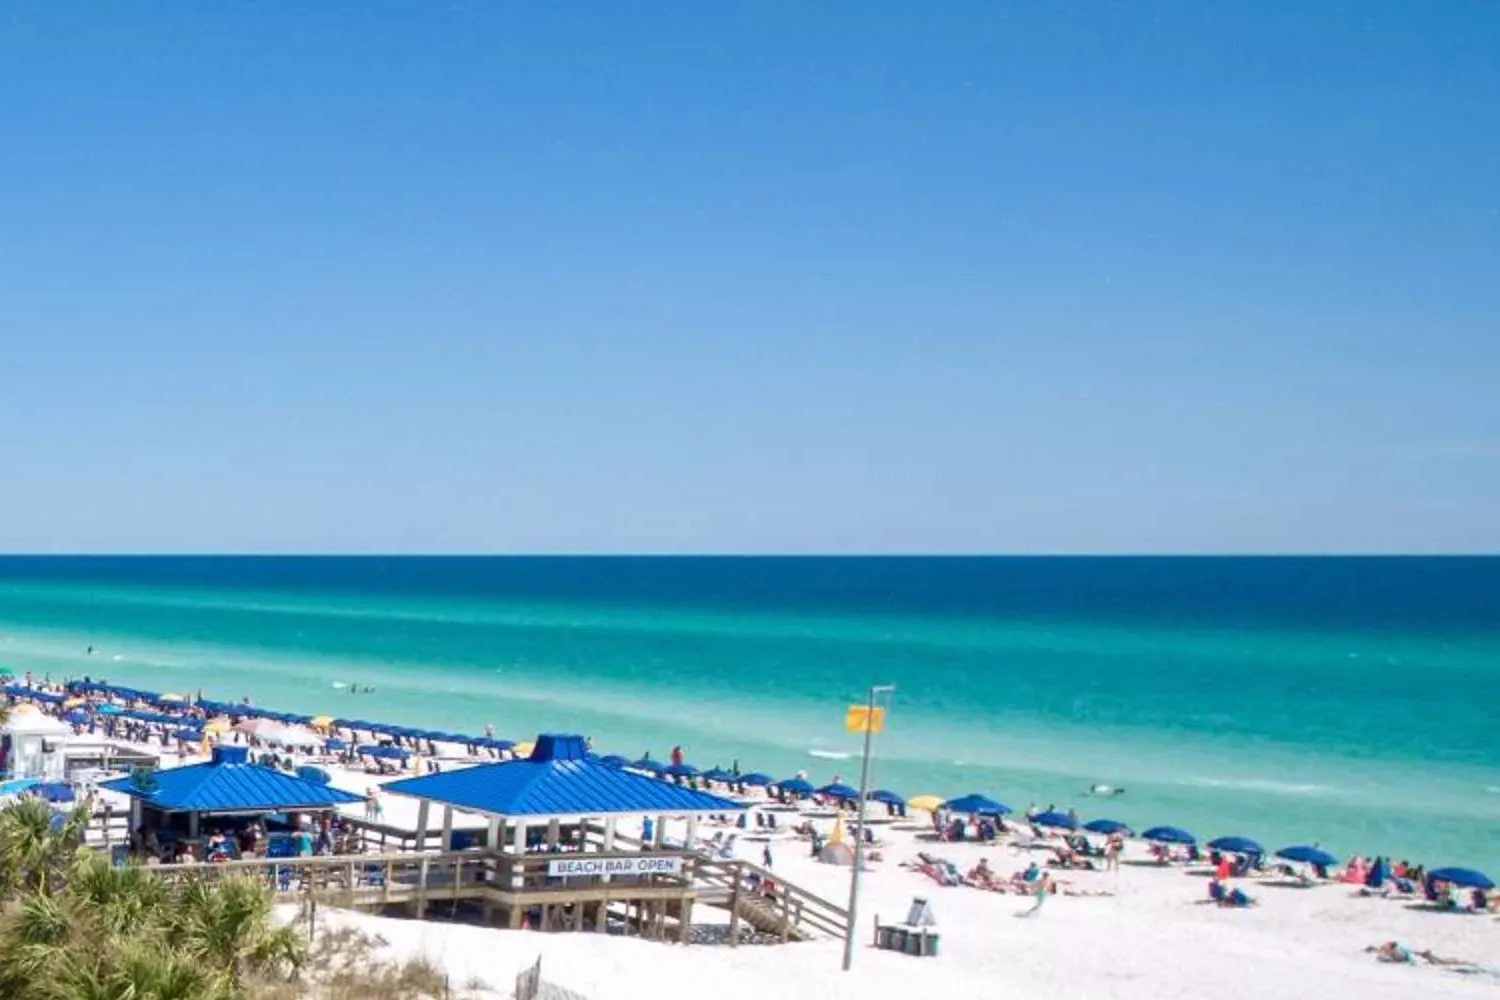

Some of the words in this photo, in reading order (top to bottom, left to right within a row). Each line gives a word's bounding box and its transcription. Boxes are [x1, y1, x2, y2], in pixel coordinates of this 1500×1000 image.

[557, 860, 602, 873] BEACH
[605, 860, 633, 871] BAR
[637, 858, 674, 870] OPEN
